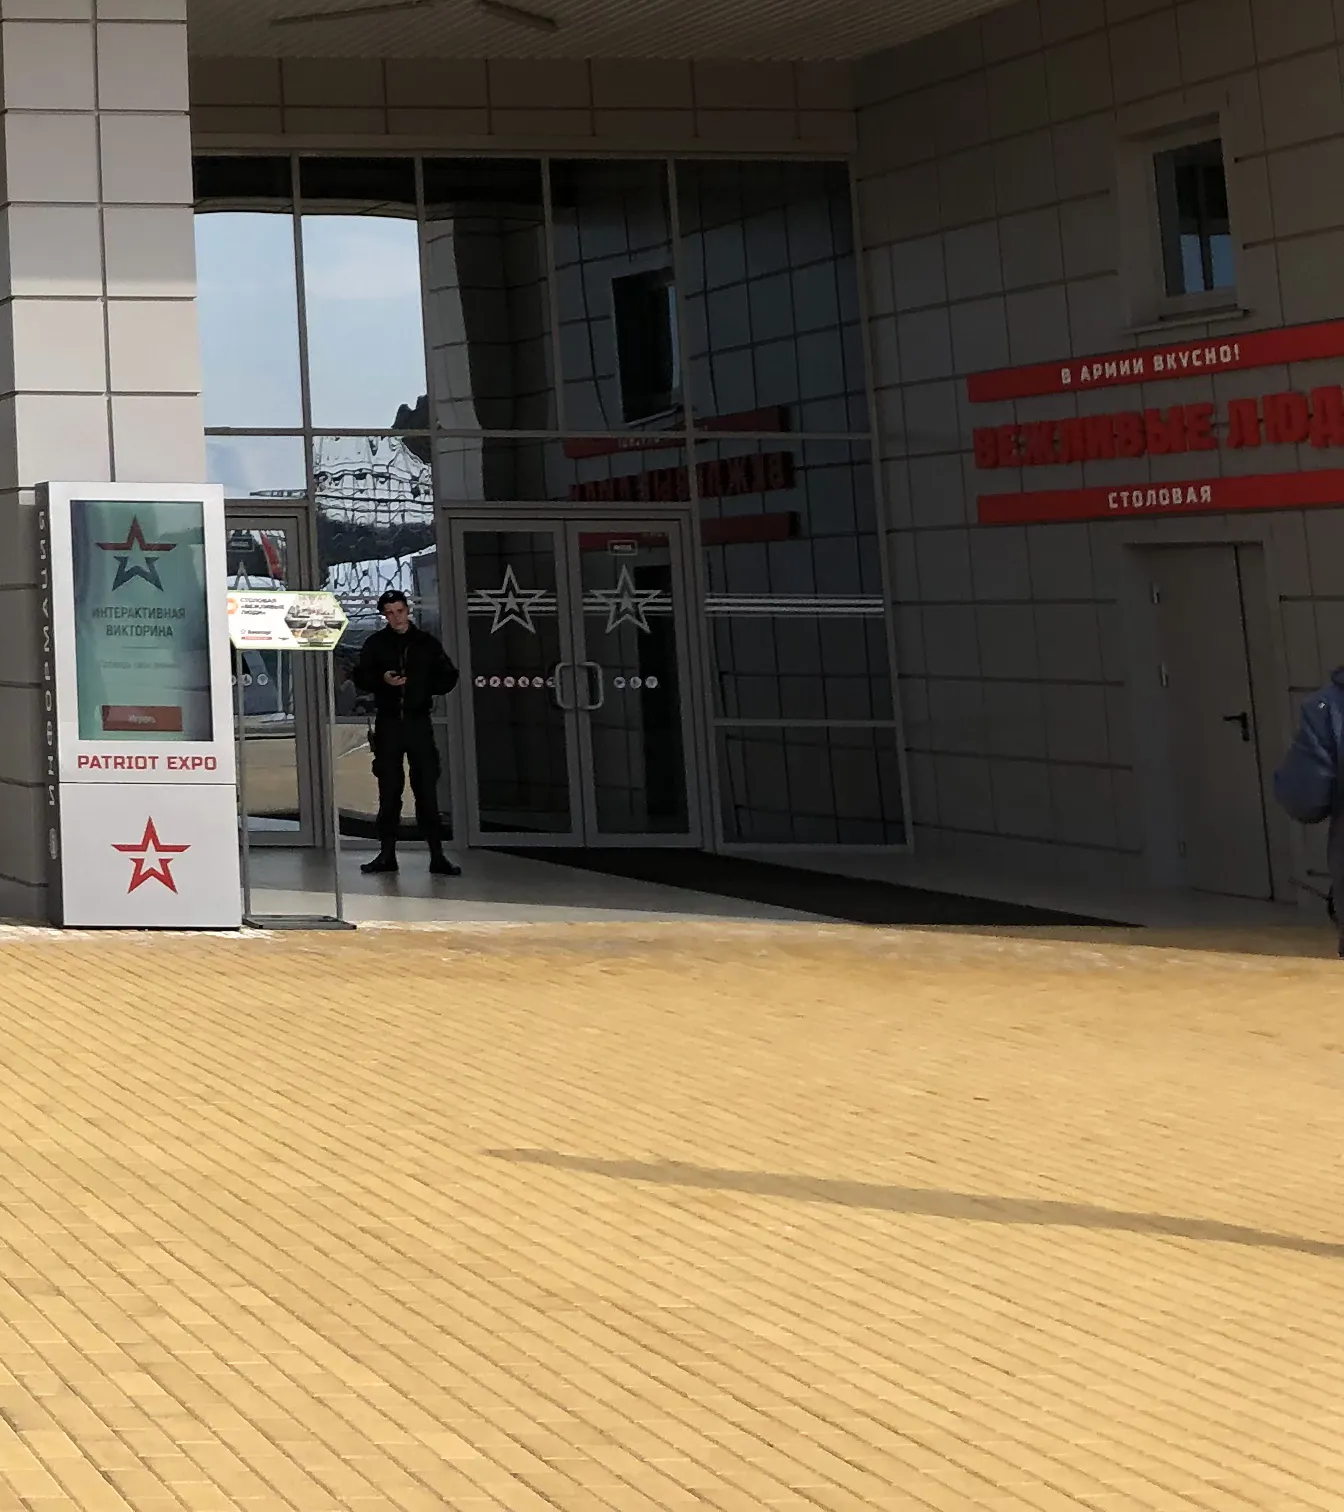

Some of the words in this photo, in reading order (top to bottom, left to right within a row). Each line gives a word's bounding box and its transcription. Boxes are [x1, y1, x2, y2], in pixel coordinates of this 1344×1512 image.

[1061, 368, 1071, 384] В
[1080, 357, 1144, 381] АРМИИ
[1154, 343, 1240, 372] ВКУСНО!
[973, 402, 1217, 469] ВЕЖЛИВЫЕ
[1108, 485, 1212, 509] СТОЛОВАЯ
[92, 606, 186, 620] ИНТЕРАКТИВНАЯ
[106, 624, 173, 637] ВИКТОРИНА
[77, 755, 160, 770] PATRIOT
[167, 756, 218, 771] EXPO
